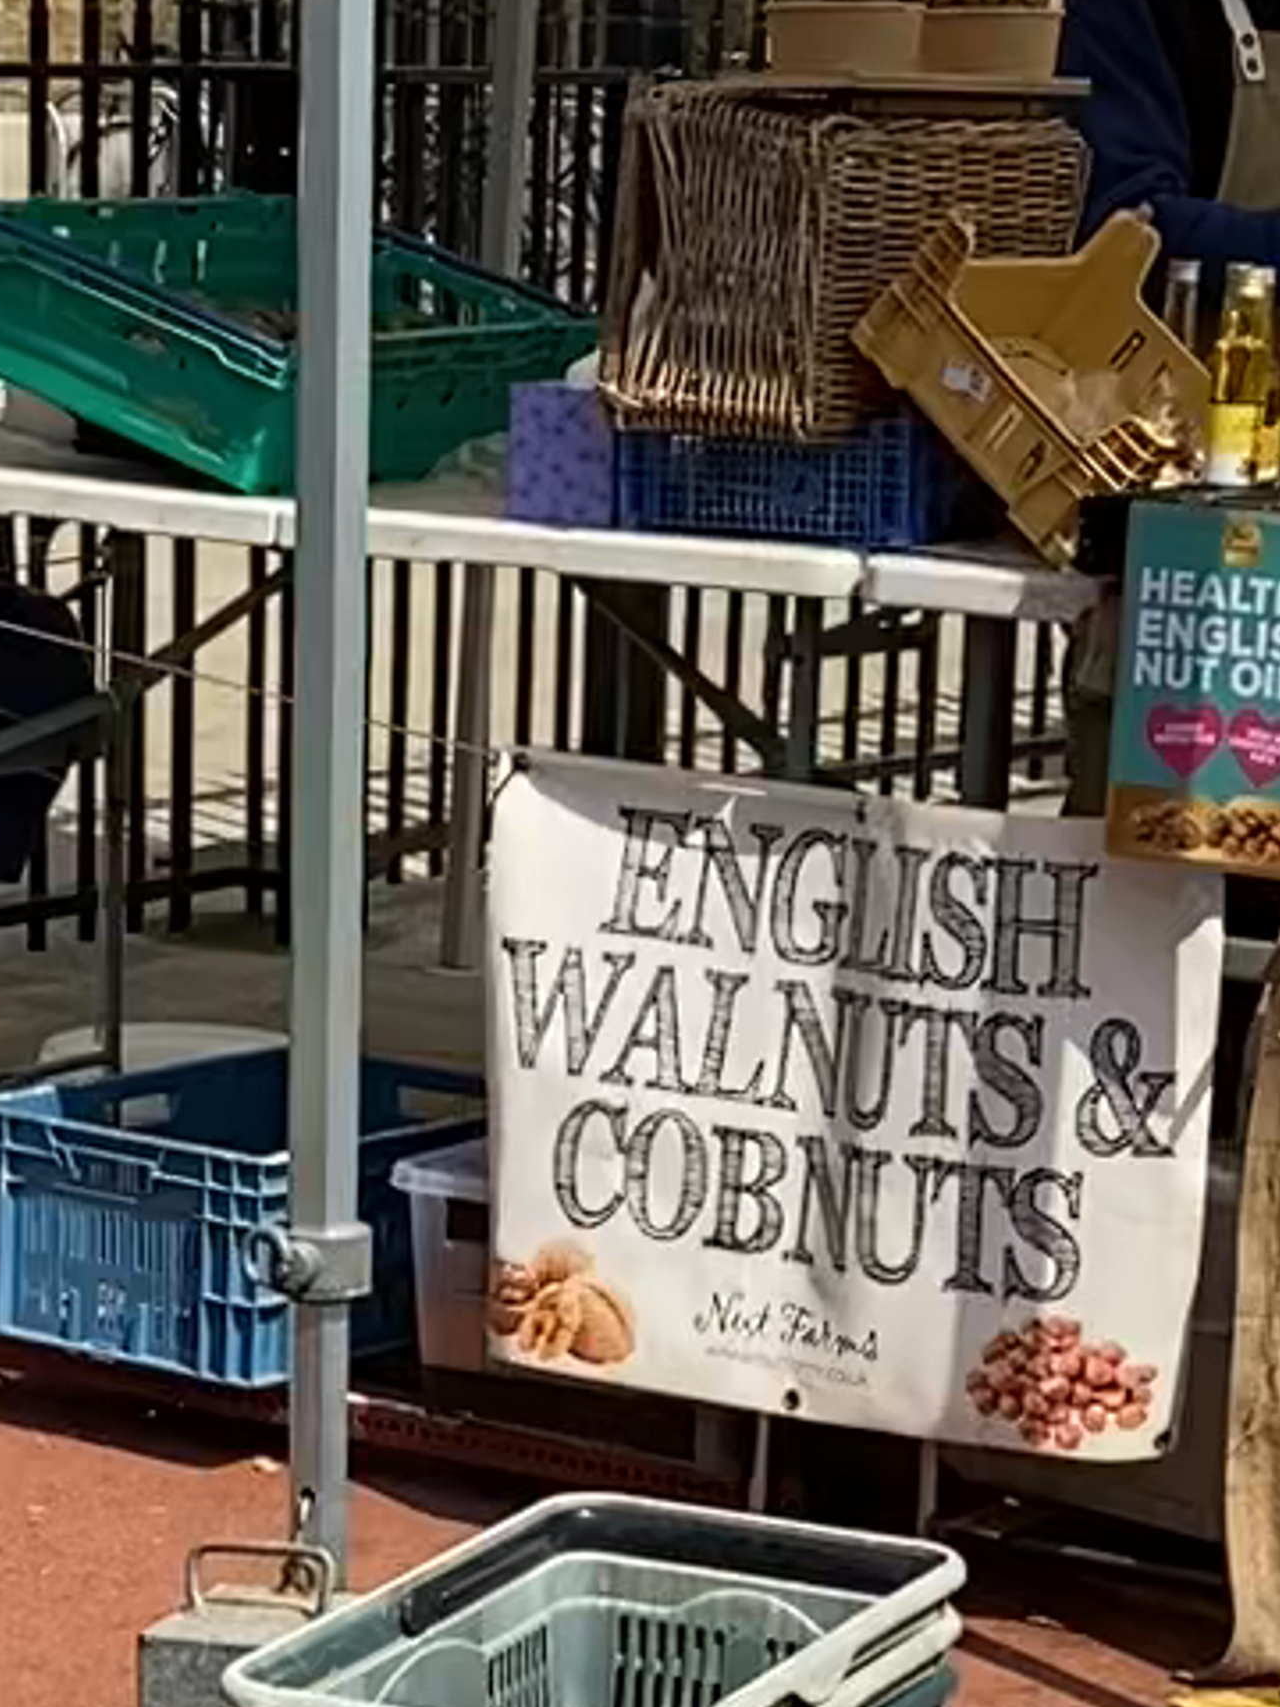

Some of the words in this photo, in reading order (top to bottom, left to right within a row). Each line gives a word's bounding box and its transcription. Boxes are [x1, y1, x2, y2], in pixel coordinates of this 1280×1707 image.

[1132, 650, 1220, 693] NUT
[599, 804, 1101, 1001] ENGLISH
[501, 936, 1045, 1150] WALNUTS
[1075, 1017, 1177, 1160] &
[552, 1099, 1084, 1303] COBNUTS
